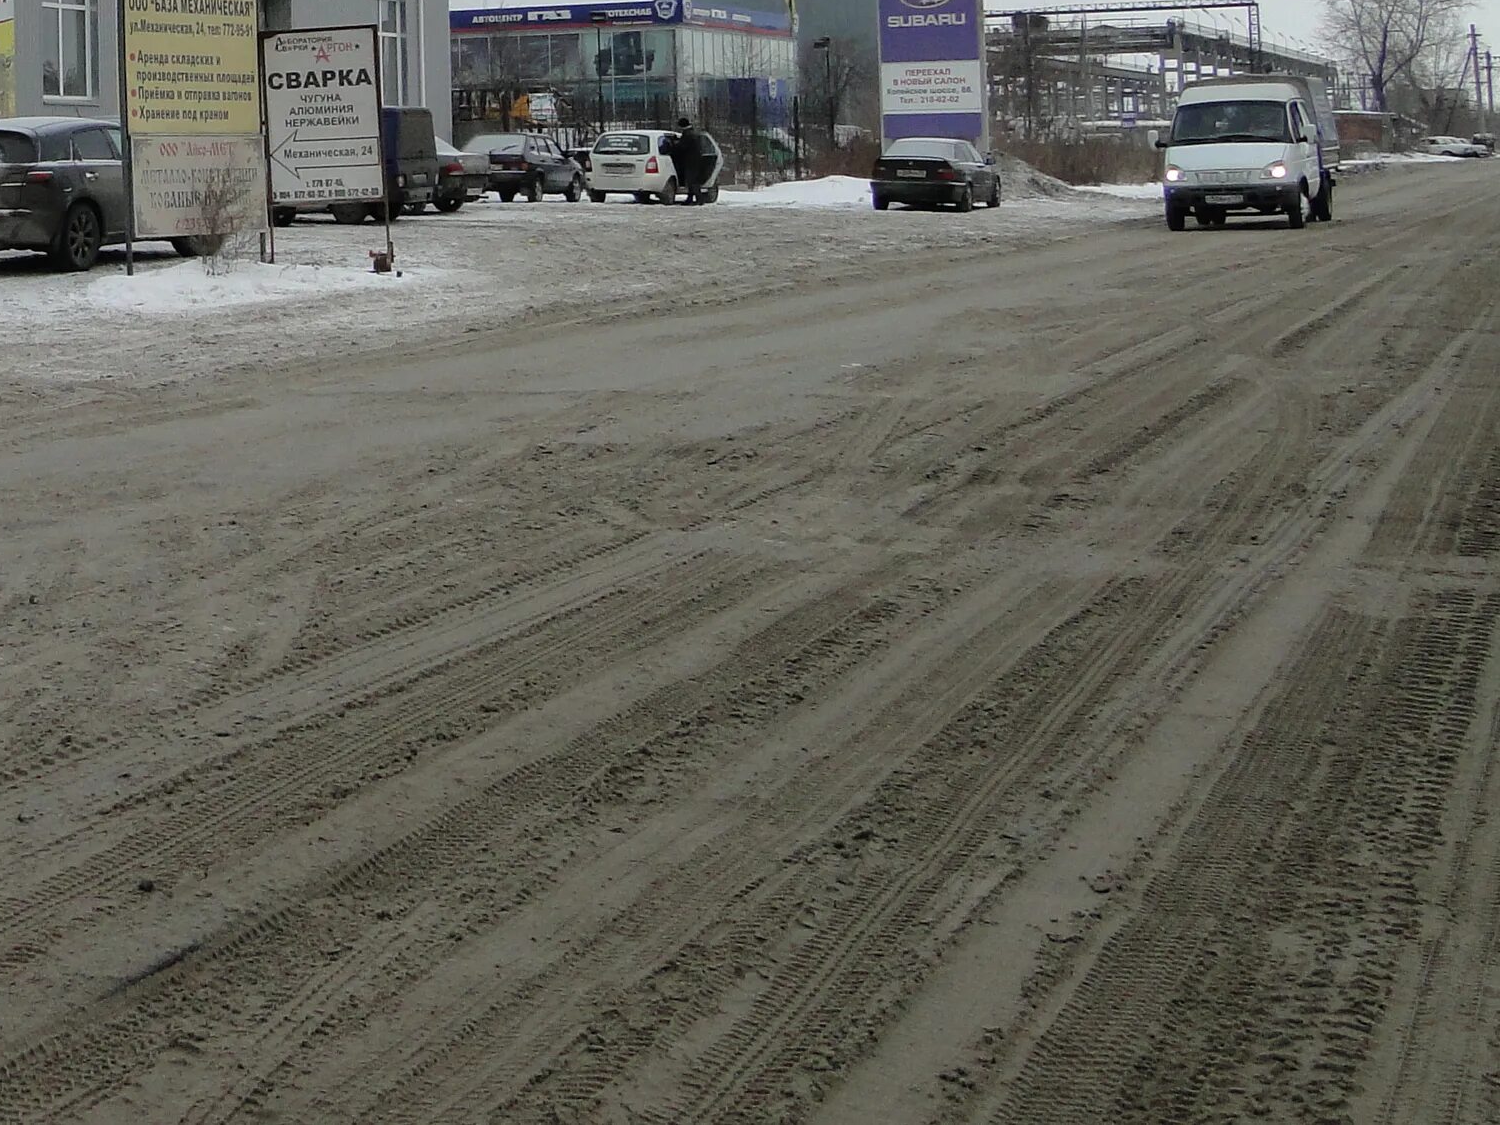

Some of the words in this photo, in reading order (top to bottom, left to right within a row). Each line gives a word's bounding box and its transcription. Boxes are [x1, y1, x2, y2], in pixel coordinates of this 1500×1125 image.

[472, 14, 522, 24] АВТОЦЕНТР
[887, 13, 966, 27] SUBARU
[137, 50, 169, 66] Аренда
[171, 54, 214, 67] складских
[136, 70, 214, 84] производственных
[216, 71, 255, 85] площадей
[268, 68, 372, 90] СВАРКА
[905, 68, 951, 76] ПЕРЕЕХАЛ
[934, 77, 966, 85] САЛОН
[138, 86, 175, 103] Приёмка
[184, 90, 221, 103] отправка
[301, 93, 341, 103] ЧУГУНА
[139, 105, 180, 121] Хранение
[182, 109, 197, 121] под
[199, 110, 229, 123] краном
[289, 104, 354, 116] АЛЮМИНИЯ
[285, 116, 359, 128] НЕРЖАВЕЙКИ
[283, 147, 359, 159] Механическая,
[361, 145, 373, 155] 24
